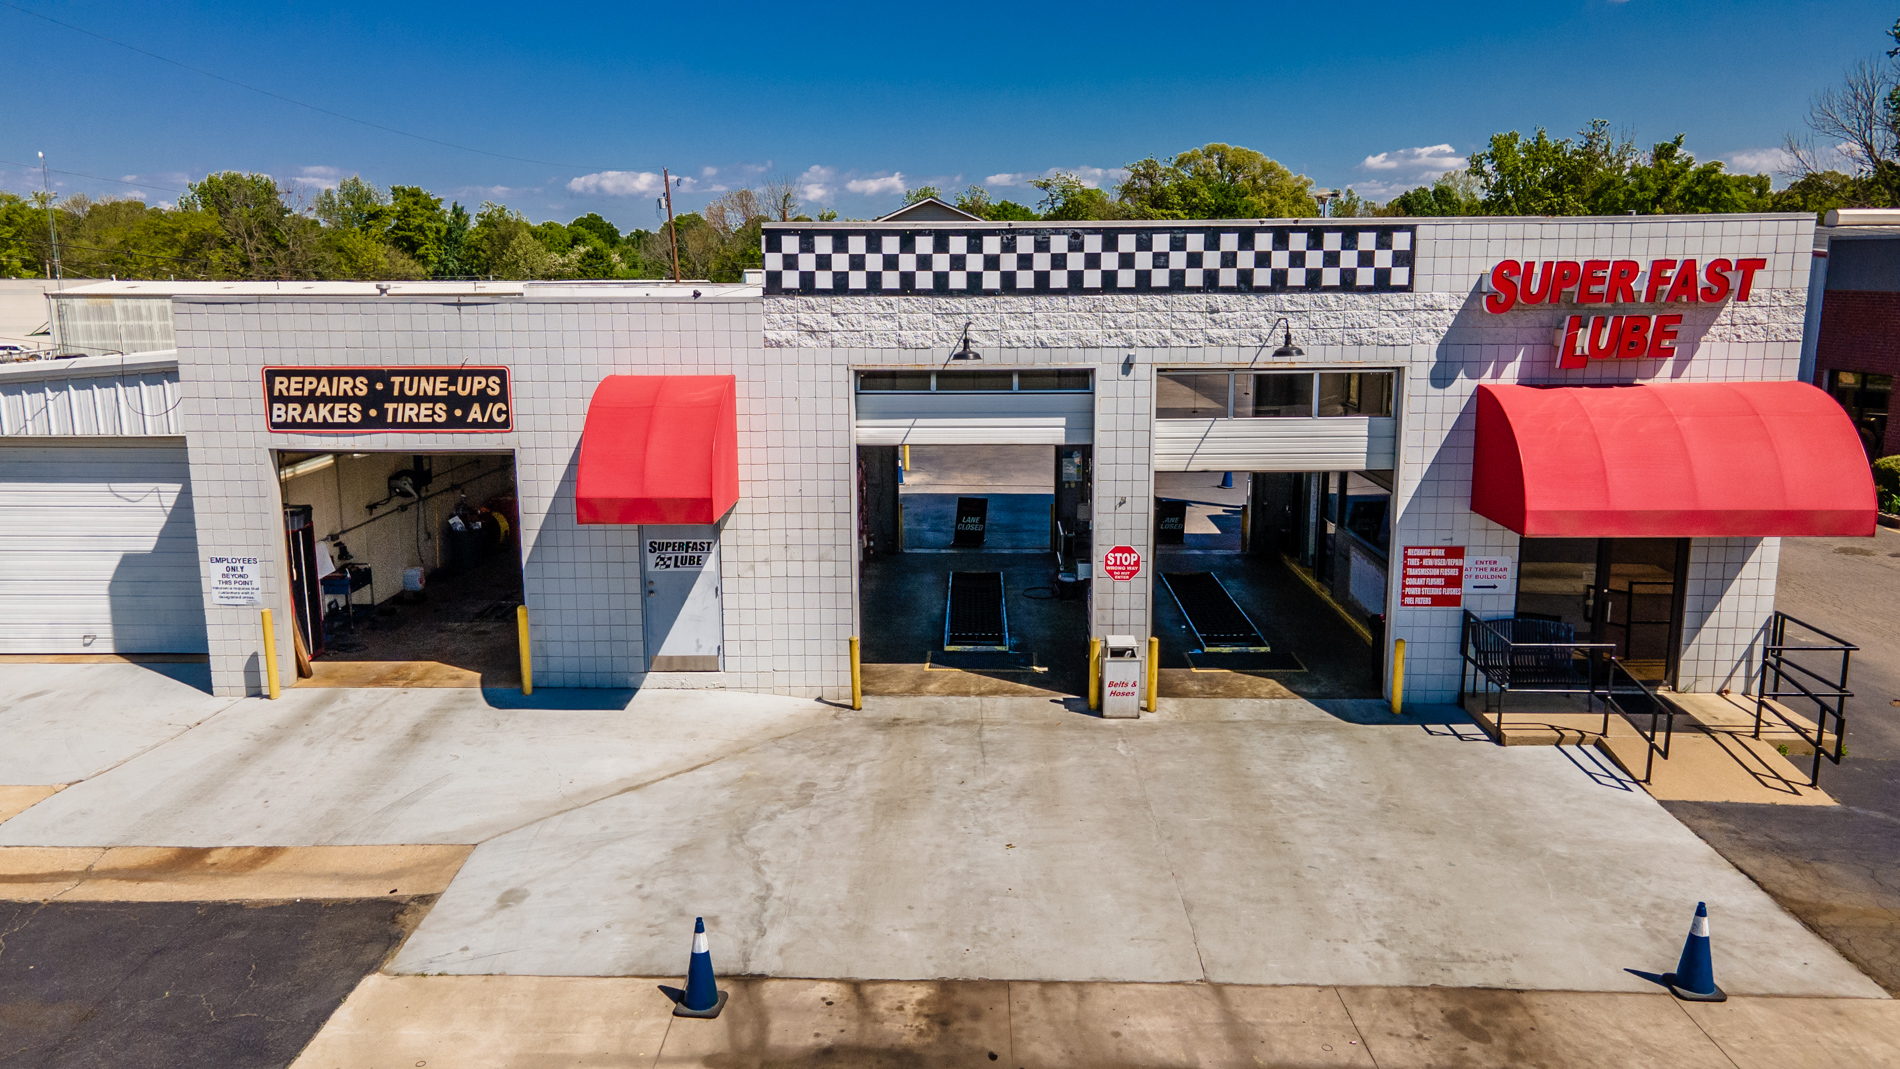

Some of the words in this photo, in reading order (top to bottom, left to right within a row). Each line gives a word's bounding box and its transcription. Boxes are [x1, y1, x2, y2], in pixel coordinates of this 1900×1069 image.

[1482, 258, 1640, 315] SUPER
[1640, 257, 1768, 304] FAST
[1556, 314, 1683, 369] LUBE
[273, 376, 369, 397] REPAIRS
[390, 375, 501, 397] TUNE-UPS
[271, 402, 363, 424] BRAKES
[383, 402, 447, 423] TIRES
[466, 402, 508, 423] A/C
[673, 555, 703, 569] LUBE
[1107, 553, 1138, 566] STOP
